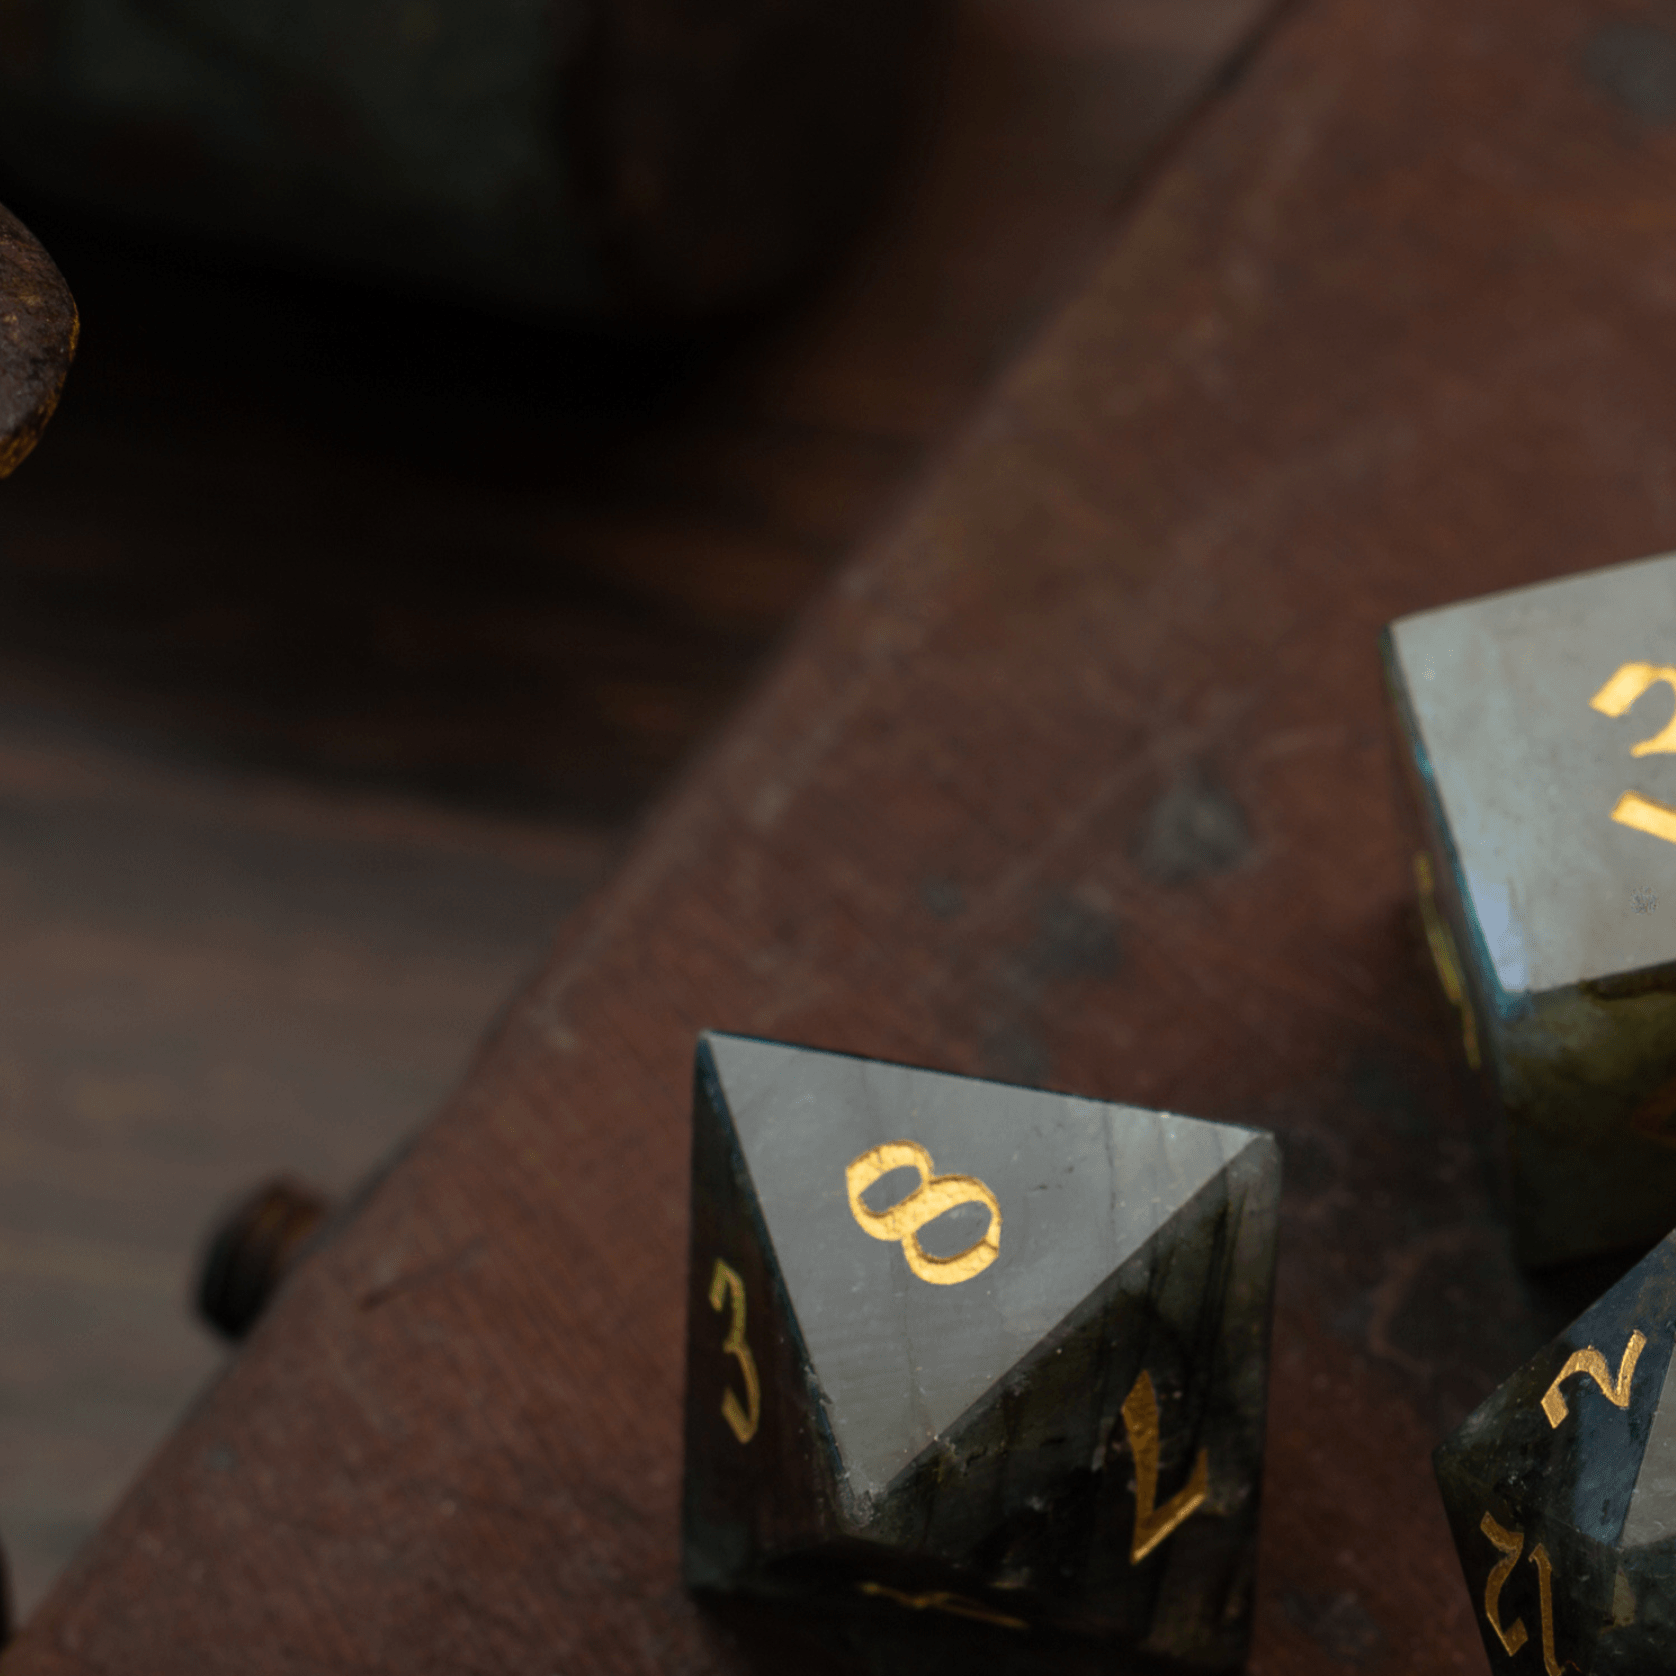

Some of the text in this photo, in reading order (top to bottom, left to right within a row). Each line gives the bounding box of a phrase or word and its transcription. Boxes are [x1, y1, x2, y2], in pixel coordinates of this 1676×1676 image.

[845, 1140, 1001, 1285] 8
[709, 1257, 760, 1444] 3
[1539, 1328, 1648, 1429] 2
